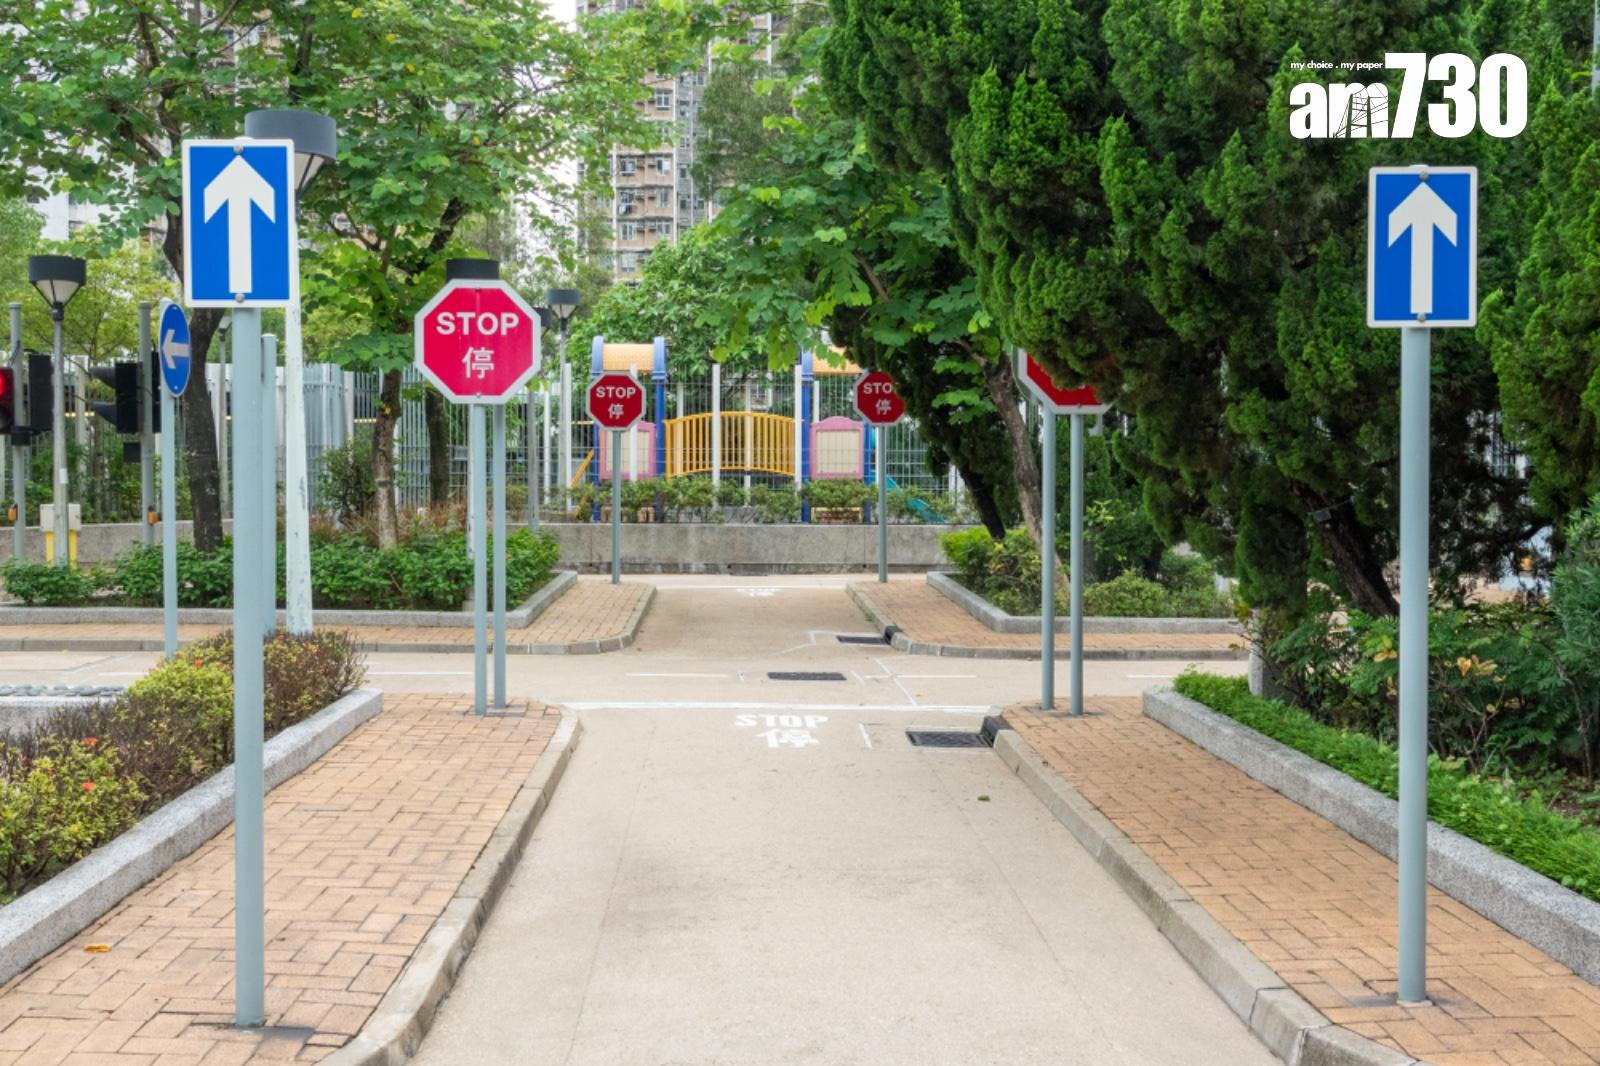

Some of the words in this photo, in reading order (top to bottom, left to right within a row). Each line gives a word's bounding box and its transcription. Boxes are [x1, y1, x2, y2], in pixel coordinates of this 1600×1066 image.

[436, 311, 520, 336] STOP
[462, 346, 495, 379] 停
[595, 386, 636, 399] STOP
[863, 382, 892, 394] STO
[608, 403, 624, 419] 停
[735, 714, 829, 728] STOP
[756, 728, 819, 748] 停
